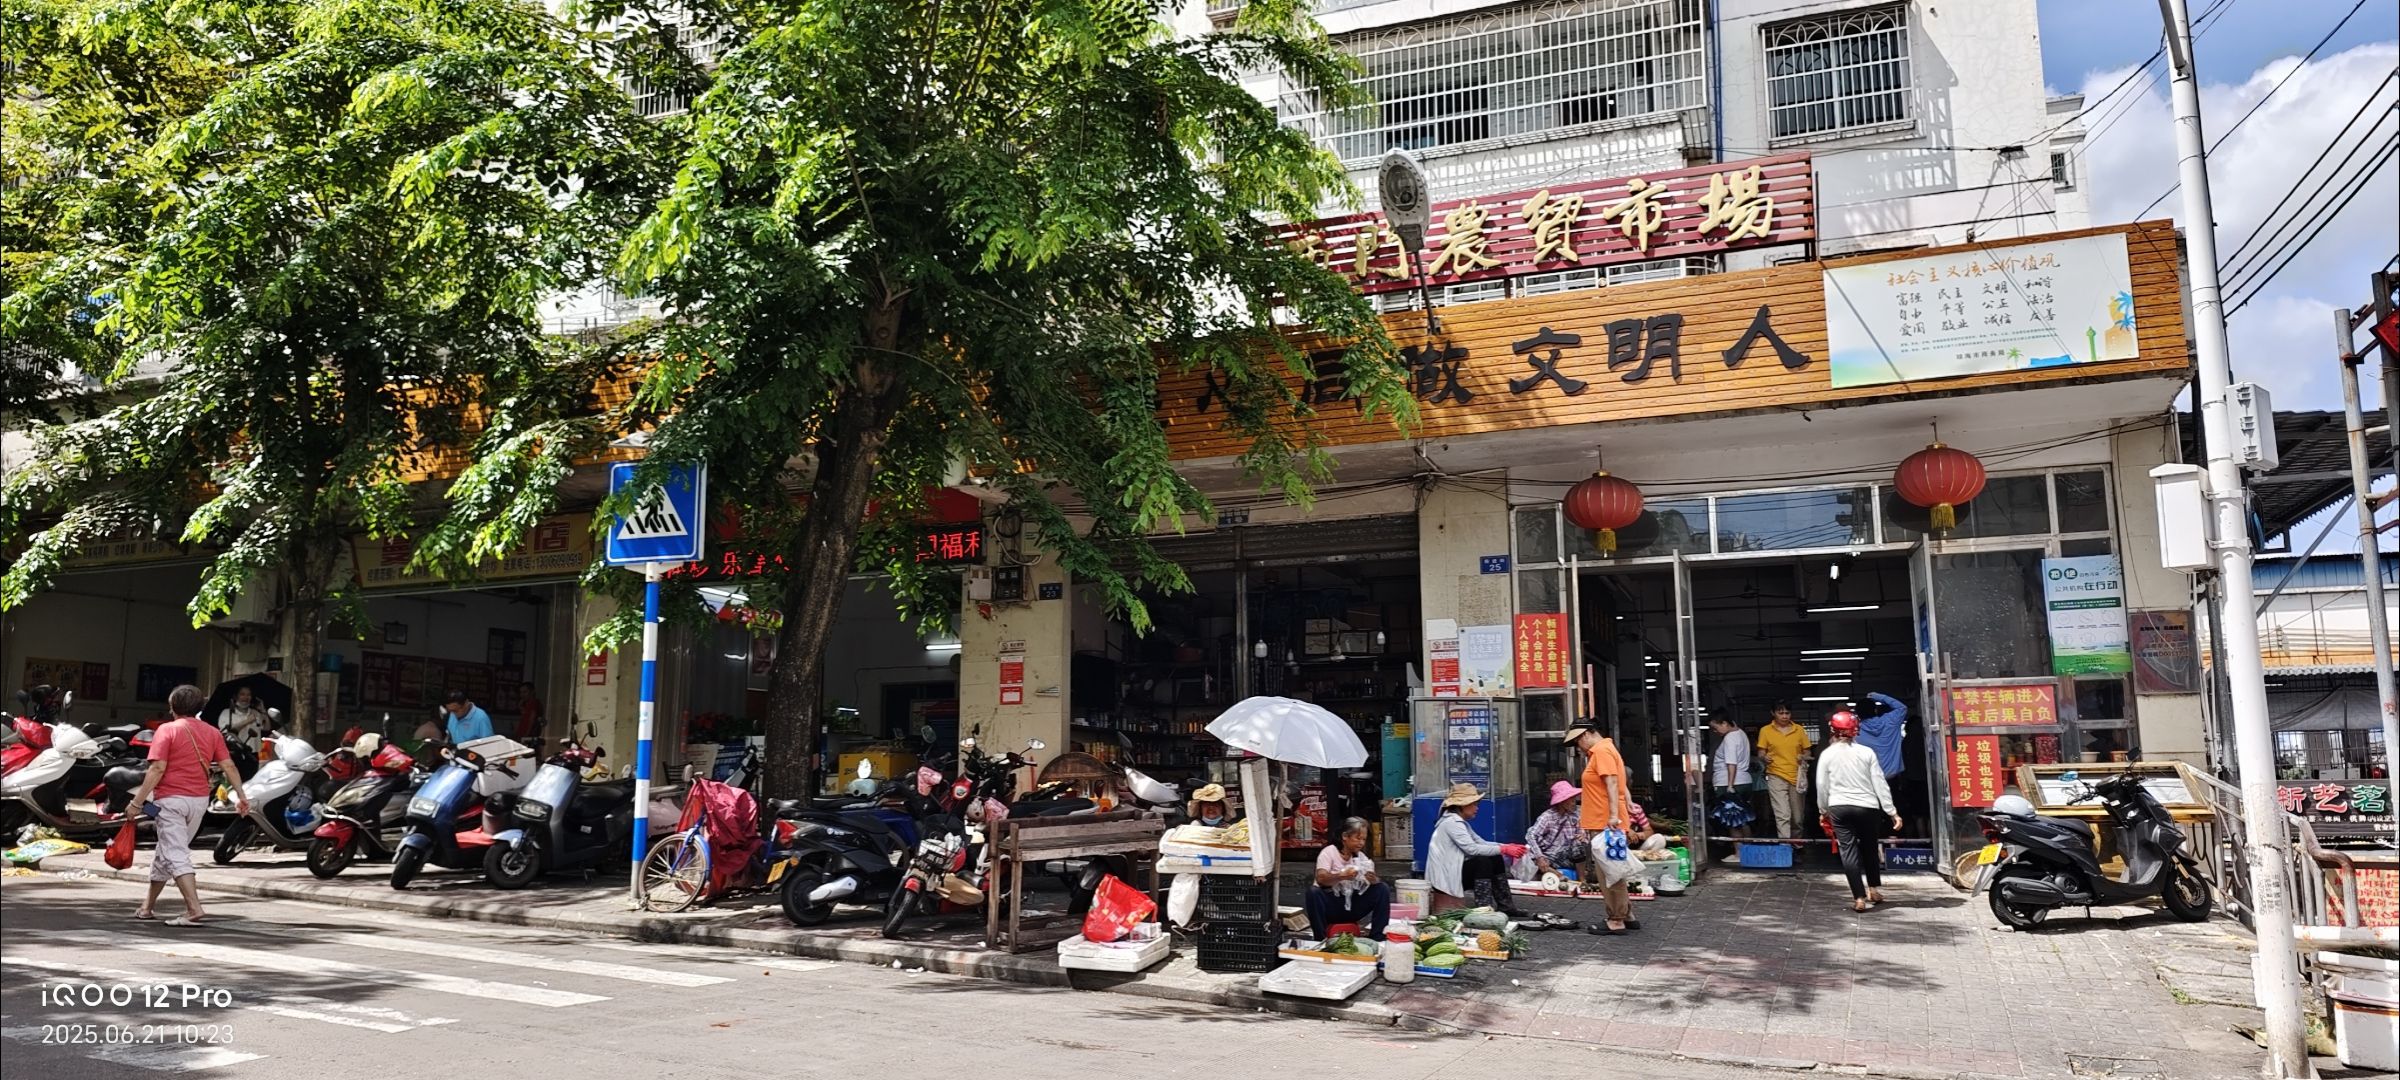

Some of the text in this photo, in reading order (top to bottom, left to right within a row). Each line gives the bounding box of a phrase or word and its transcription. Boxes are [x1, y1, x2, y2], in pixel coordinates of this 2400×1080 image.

[1887, 252, 2061, 287] 社会主义核心价值观
[1896, 276, 2053, 306] 富强 民主 文明 和谐
[1899, 292, 2054, 321] 自由 平等 公正 法治
[1899, 308, 2056, 337] 爱国 敬业 诚信 友善
[1489, 563, 1502, 572] 25
[1046, 590, 1057, 598] 23
[1546, 618, 1558, 683] 畅通生命通道
[1957, 740, 1973, 802] 分类不可少
[1976, 740, 1996, 802] 垃圾也有宝
[2276, 783, 2387, 814] 新艺茗
